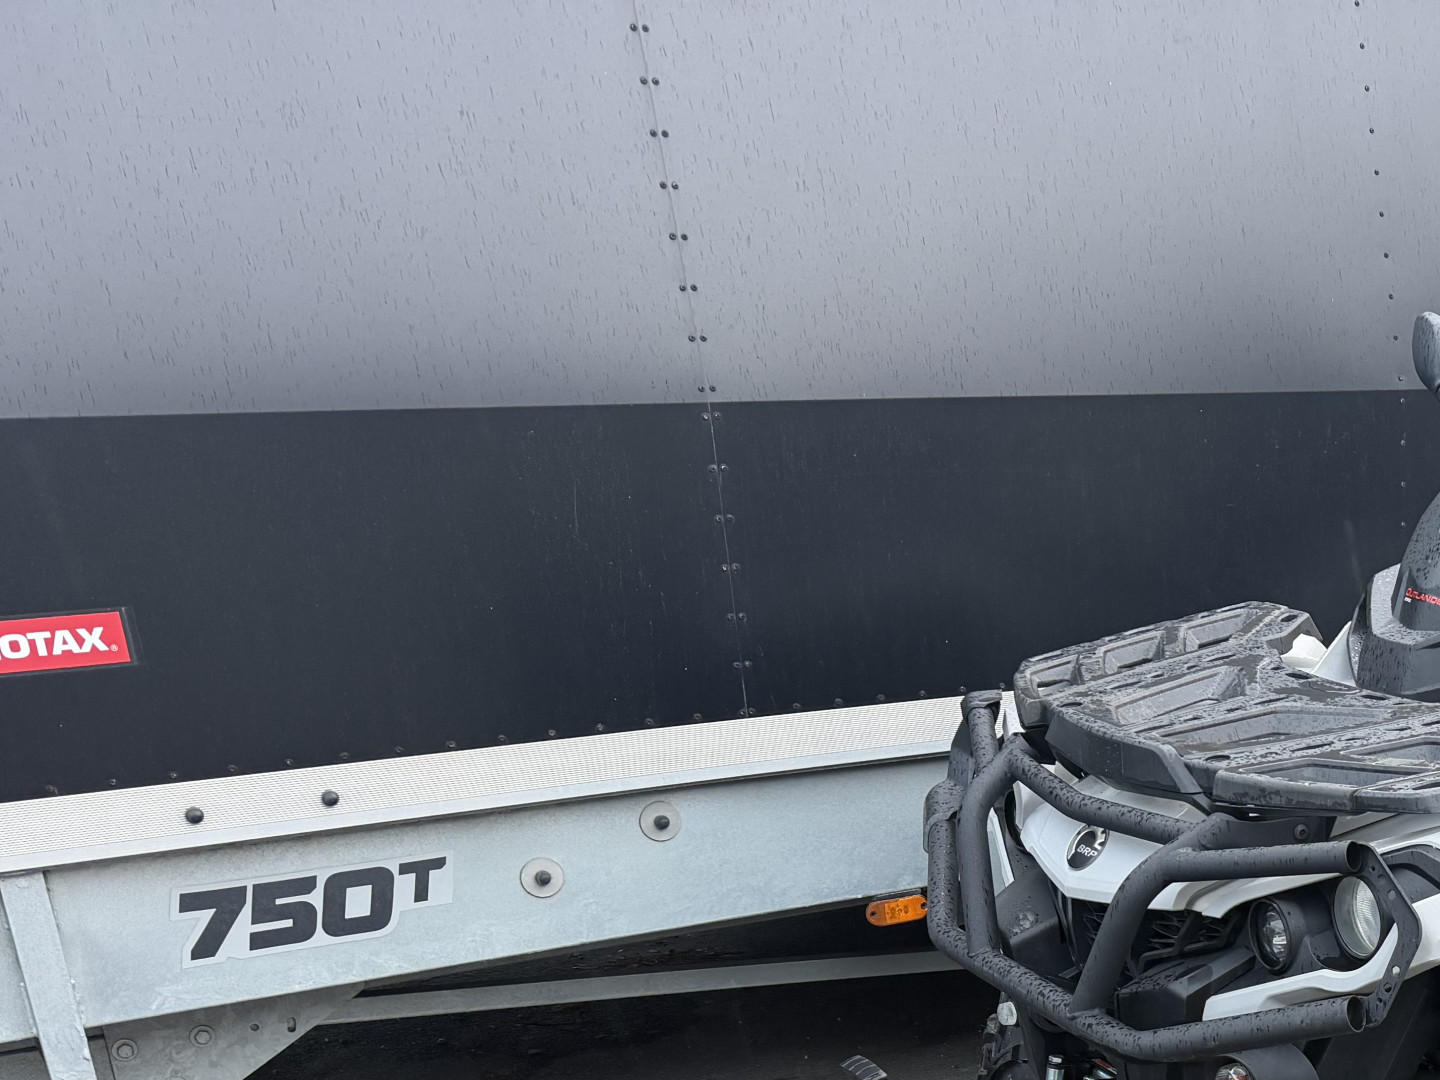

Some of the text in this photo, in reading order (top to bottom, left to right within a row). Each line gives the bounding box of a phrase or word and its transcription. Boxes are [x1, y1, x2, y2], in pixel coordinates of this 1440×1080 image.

[0, 626, 110, 660] OTAX
[1077, 844, 1098, 857] BRP
[178, 856, 447, 961] 750T
